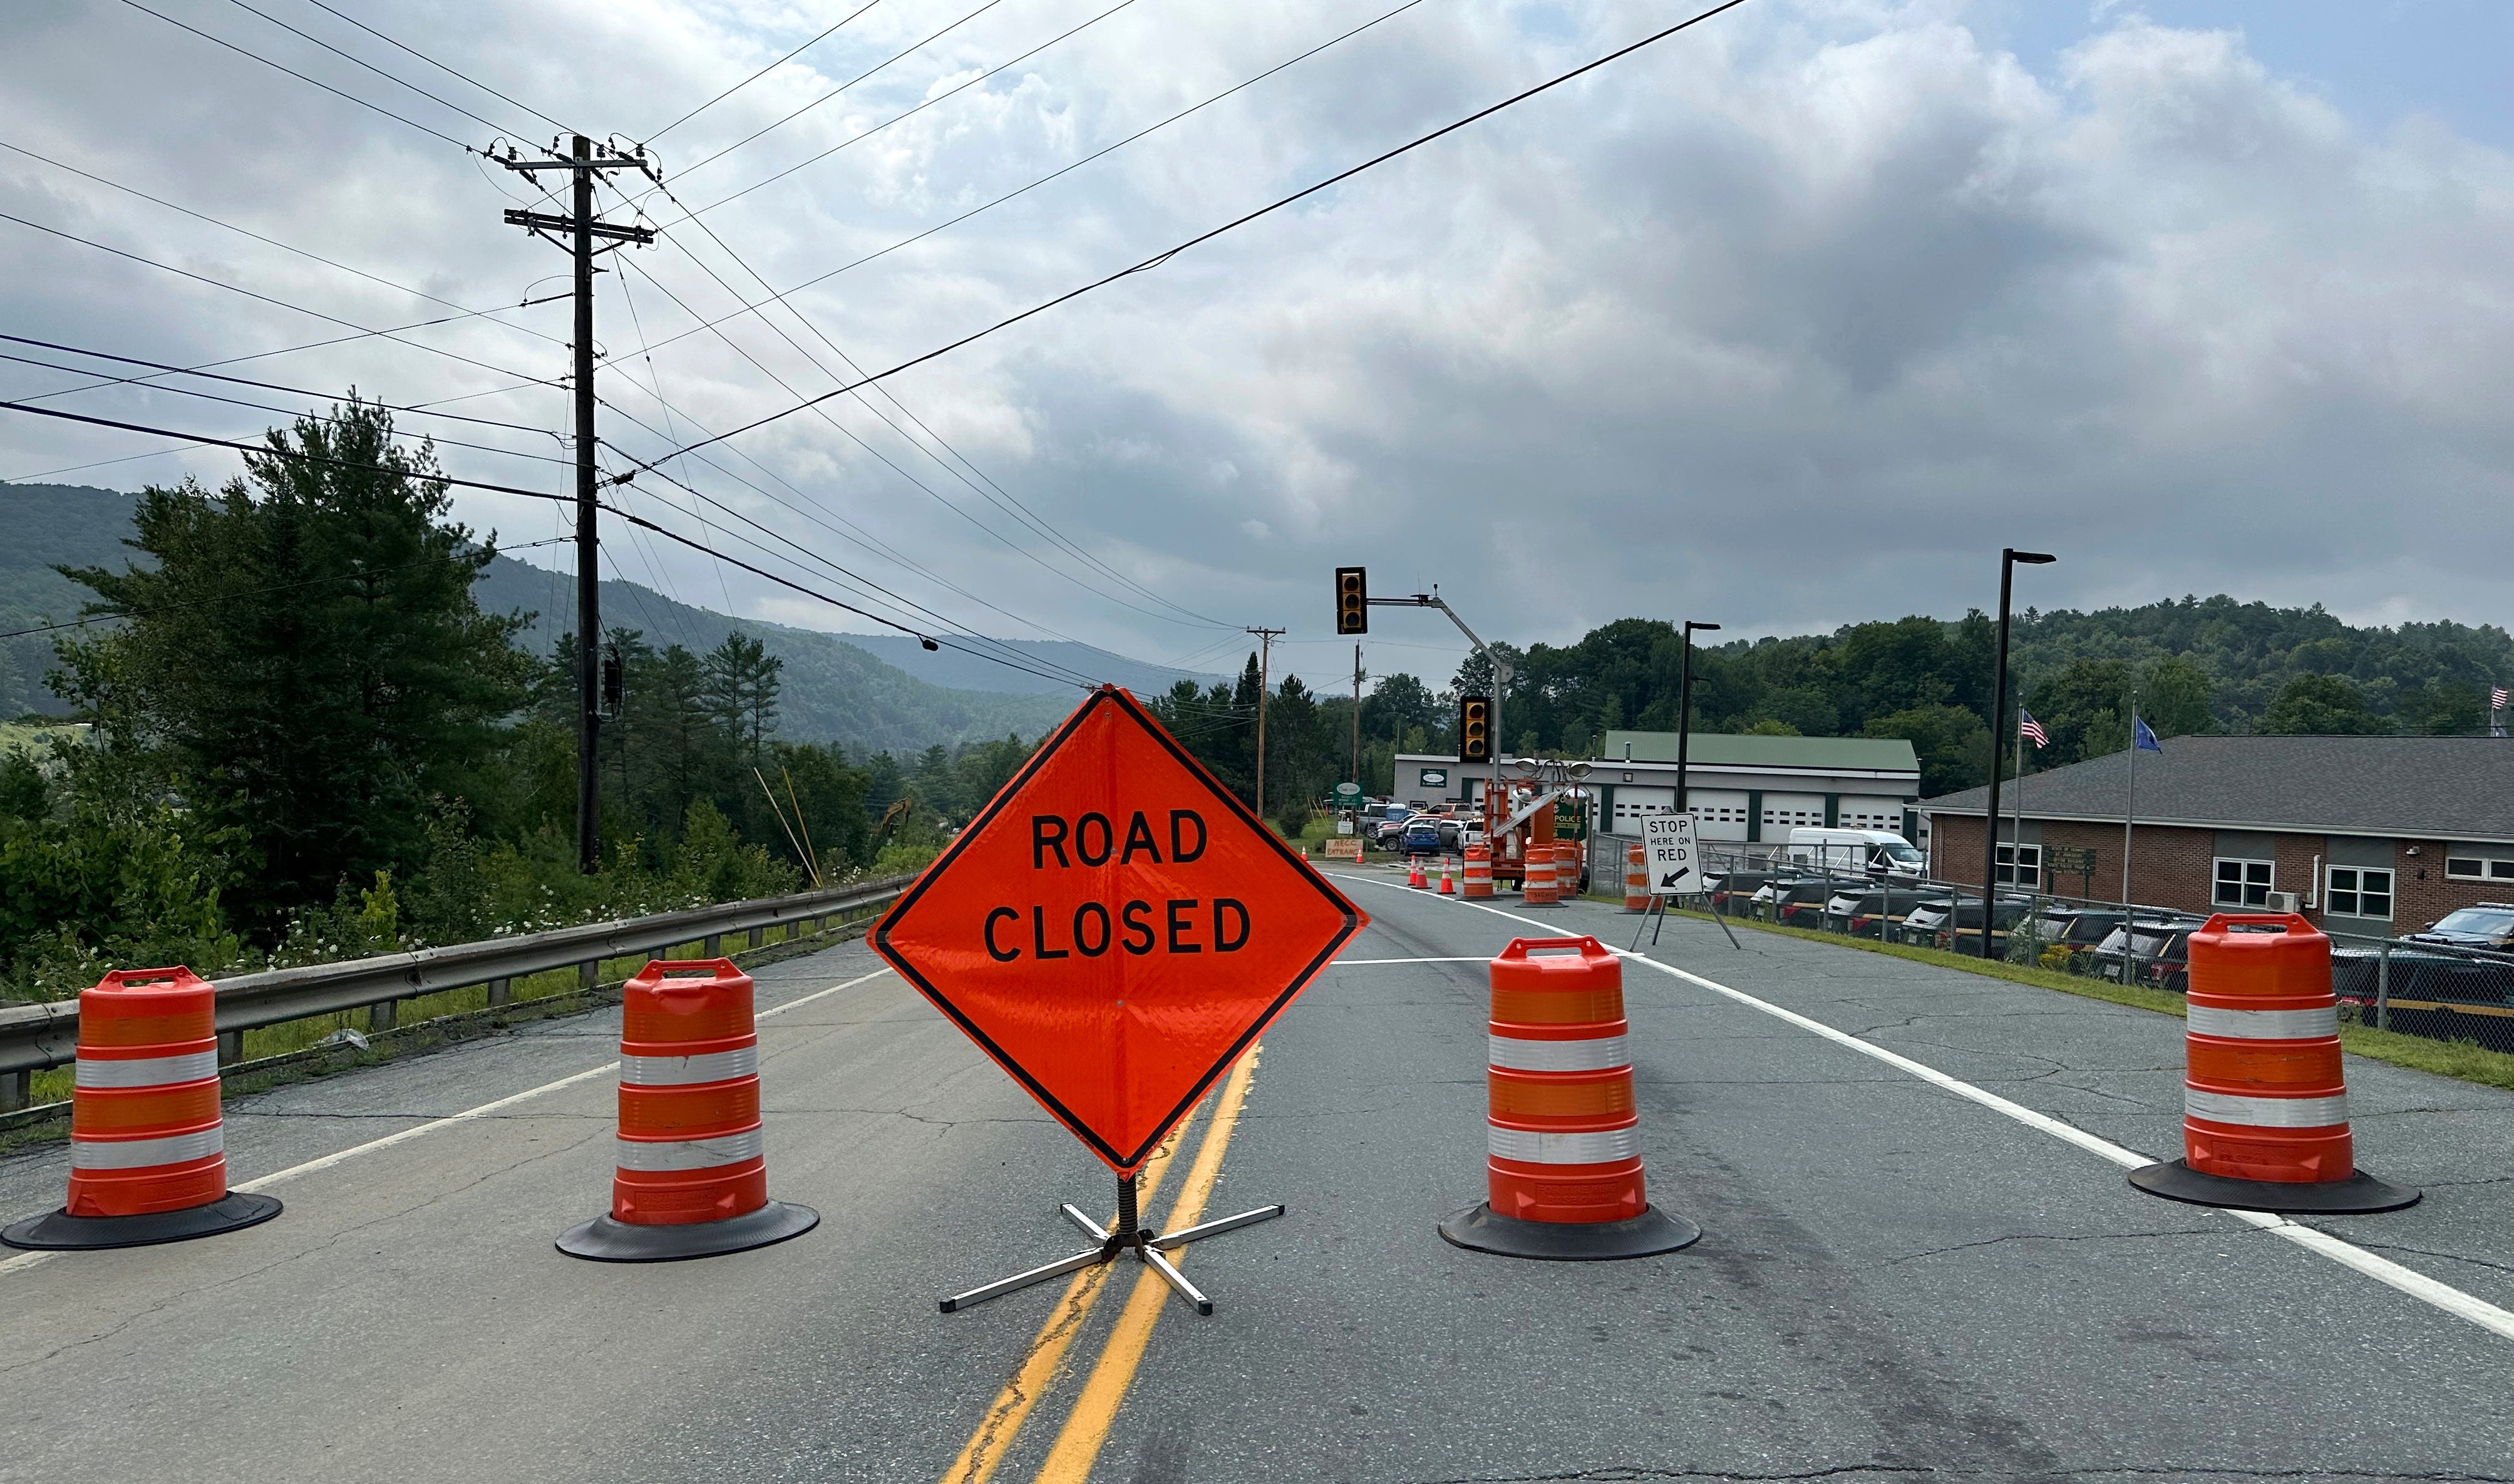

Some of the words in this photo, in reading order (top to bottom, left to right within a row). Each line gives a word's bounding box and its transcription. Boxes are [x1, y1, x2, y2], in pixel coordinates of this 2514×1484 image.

[1554, 815, 1581, 823] POLICE
[1649, 820, 1687, 833] STOP
[1032, 809, 1207, 870] ROAD
[1650, 837, 1674, 845] HERE
[1678, 837, 1691, 845] ON
[1657, 848, 1687, 861] RED
[984, 898, 1250, 962] CLOSED
